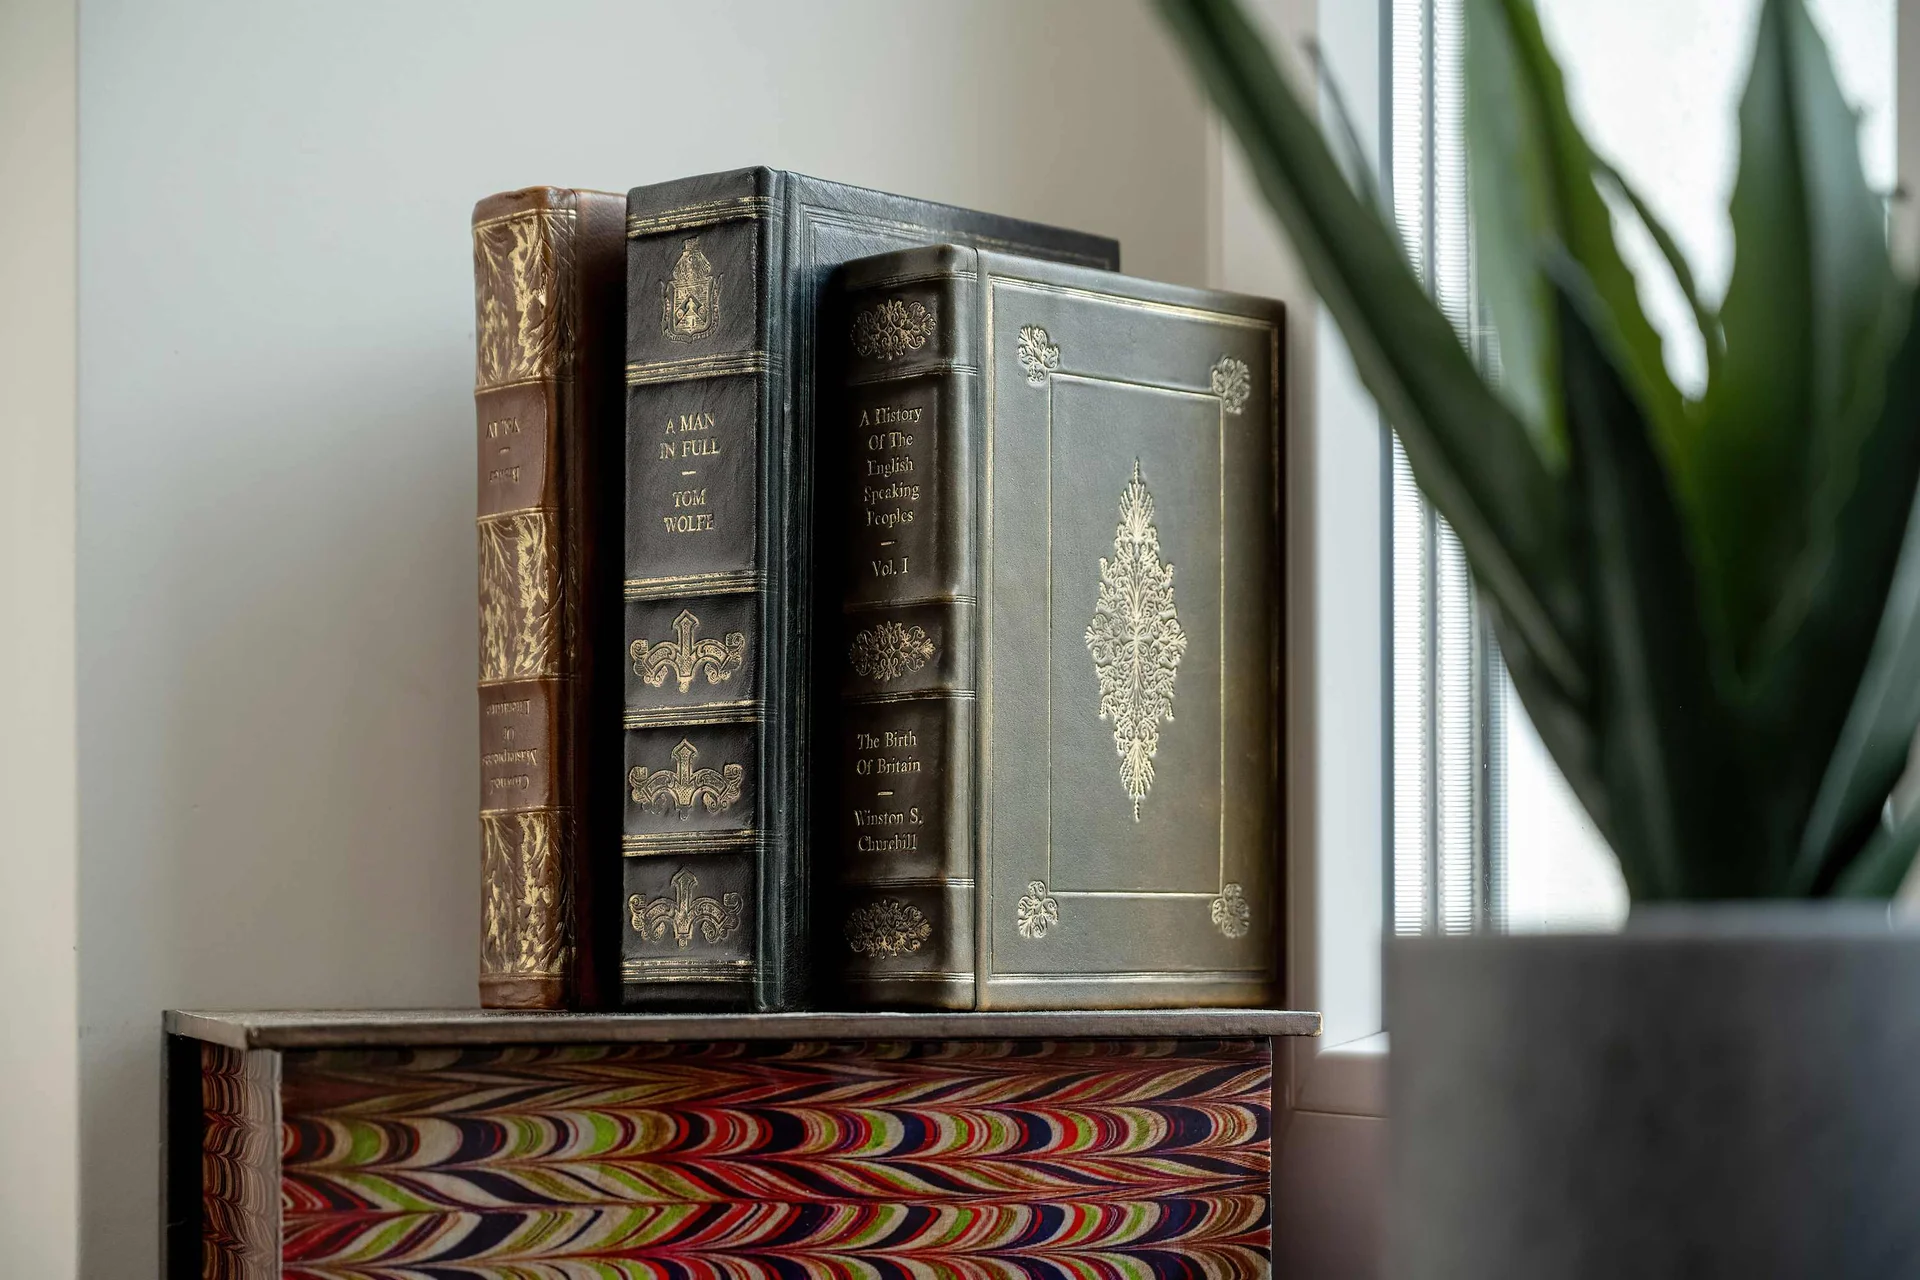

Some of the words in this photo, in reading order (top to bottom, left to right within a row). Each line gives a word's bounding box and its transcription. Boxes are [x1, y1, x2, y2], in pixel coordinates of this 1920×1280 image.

[665, 418, 676, 434] A
[680, 412, 716, 432] MAN
[859, 409, 871, 428] A
[875, 407, 923, 426] History
[660, 441, 676, 460] IN
[682, 437, 720, 457] FULL
[868, 433, 886, 451] Of
[889, 431, 914, 449] The
[867, 456, 914, 478] English
[672, 488, 707, 508] TOM
[864, 481, 920, 505] Speaking
[663, 513, 715, 533] WOLFE
[866, 507, 914, 529] Peoples
[871, 559, 897, 577] Vol.
[901, 556, 910, 575] I
[857, 732, 880, 751] The
[885, 730, 918, 748] Birth
[856, 759, 873, 776] Of
[876, 756, 921, 774] Britain
[854, 808, 904, 827] Winston
[909, 806, 923, 825] S.
[858, 833, 918, 852] Churchill
